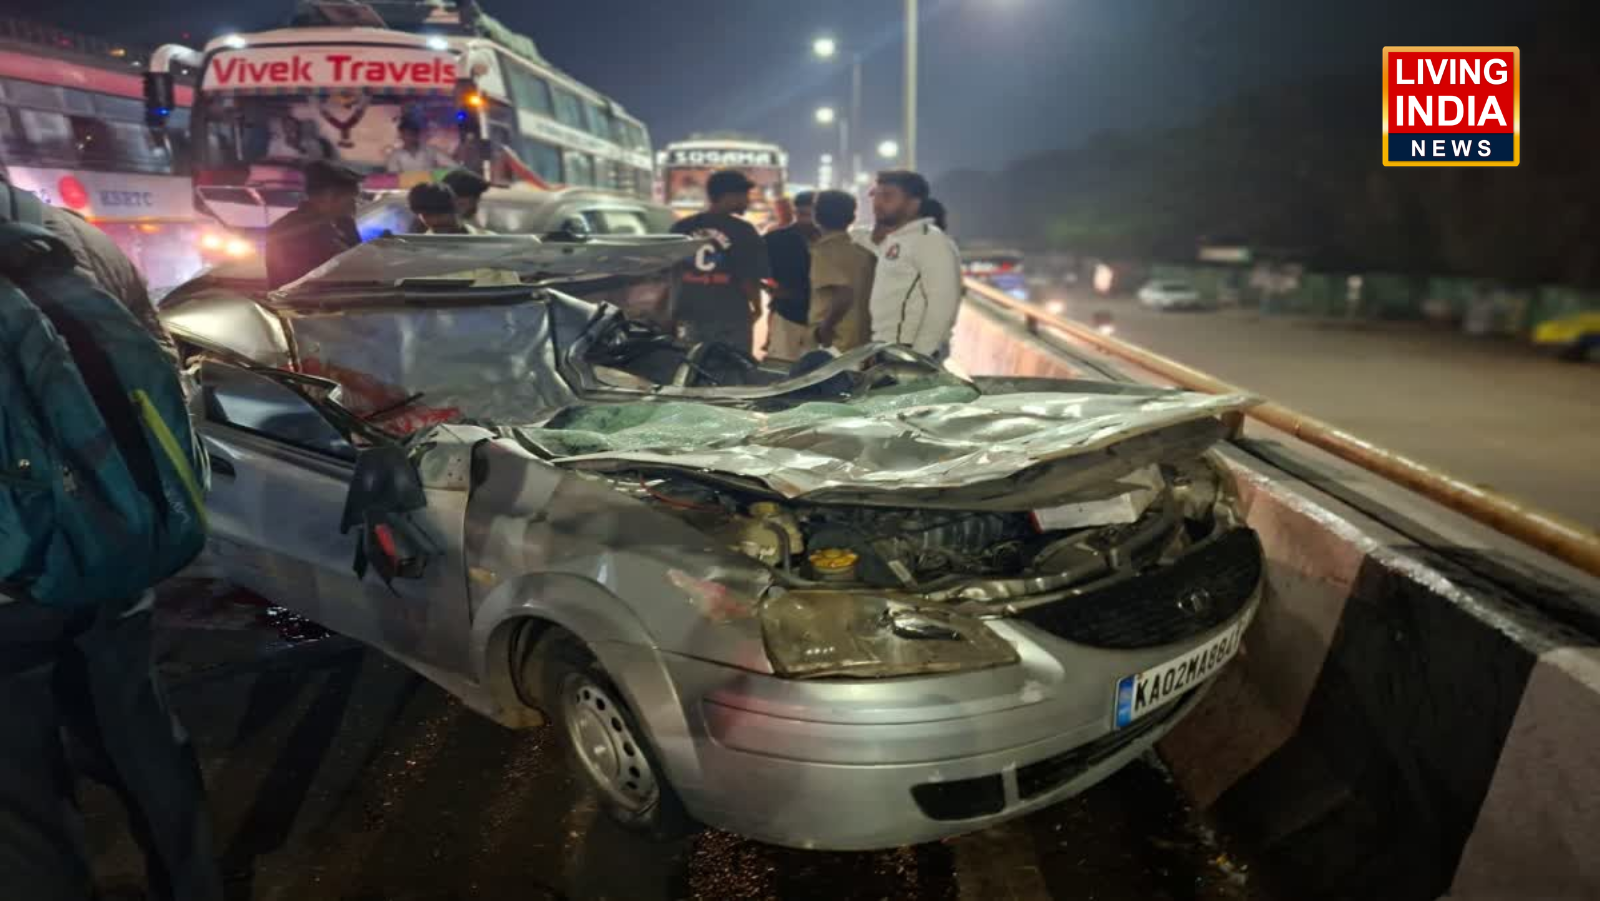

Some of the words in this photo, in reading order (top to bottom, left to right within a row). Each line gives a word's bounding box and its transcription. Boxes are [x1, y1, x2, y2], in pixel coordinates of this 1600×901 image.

[213, 55, 312, 84] Vivek
[325, 55, 457, 84] Travels
[694, 243, 716, 271] C
